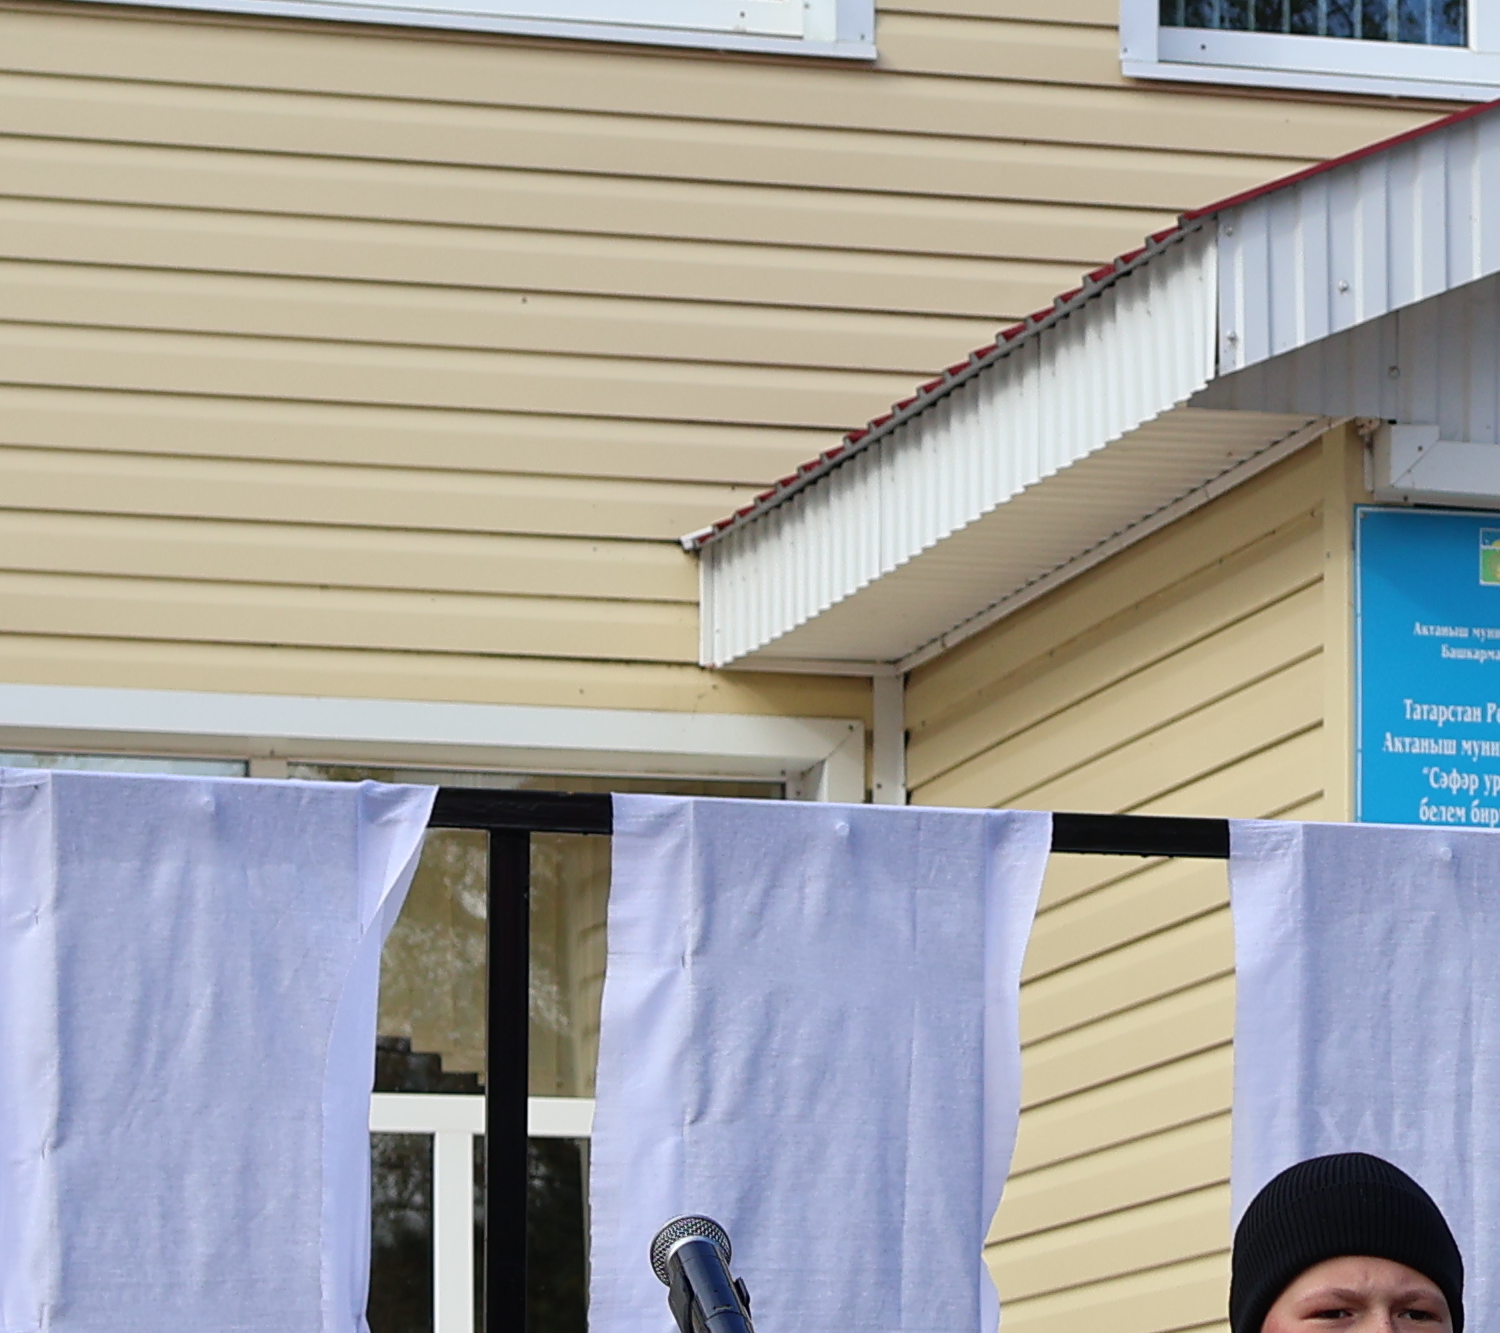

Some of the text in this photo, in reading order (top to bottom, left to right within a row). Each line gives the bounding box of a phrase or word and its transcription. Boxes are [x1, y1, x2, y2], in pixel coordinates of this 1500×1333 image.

[1413, 621, 1469, 638] Актаныш
[1403, 699, 1482, 727] Татарстан
[1382, 731, 1457, 756] Актаныш
[1419, 797, 1466, 822] белем
